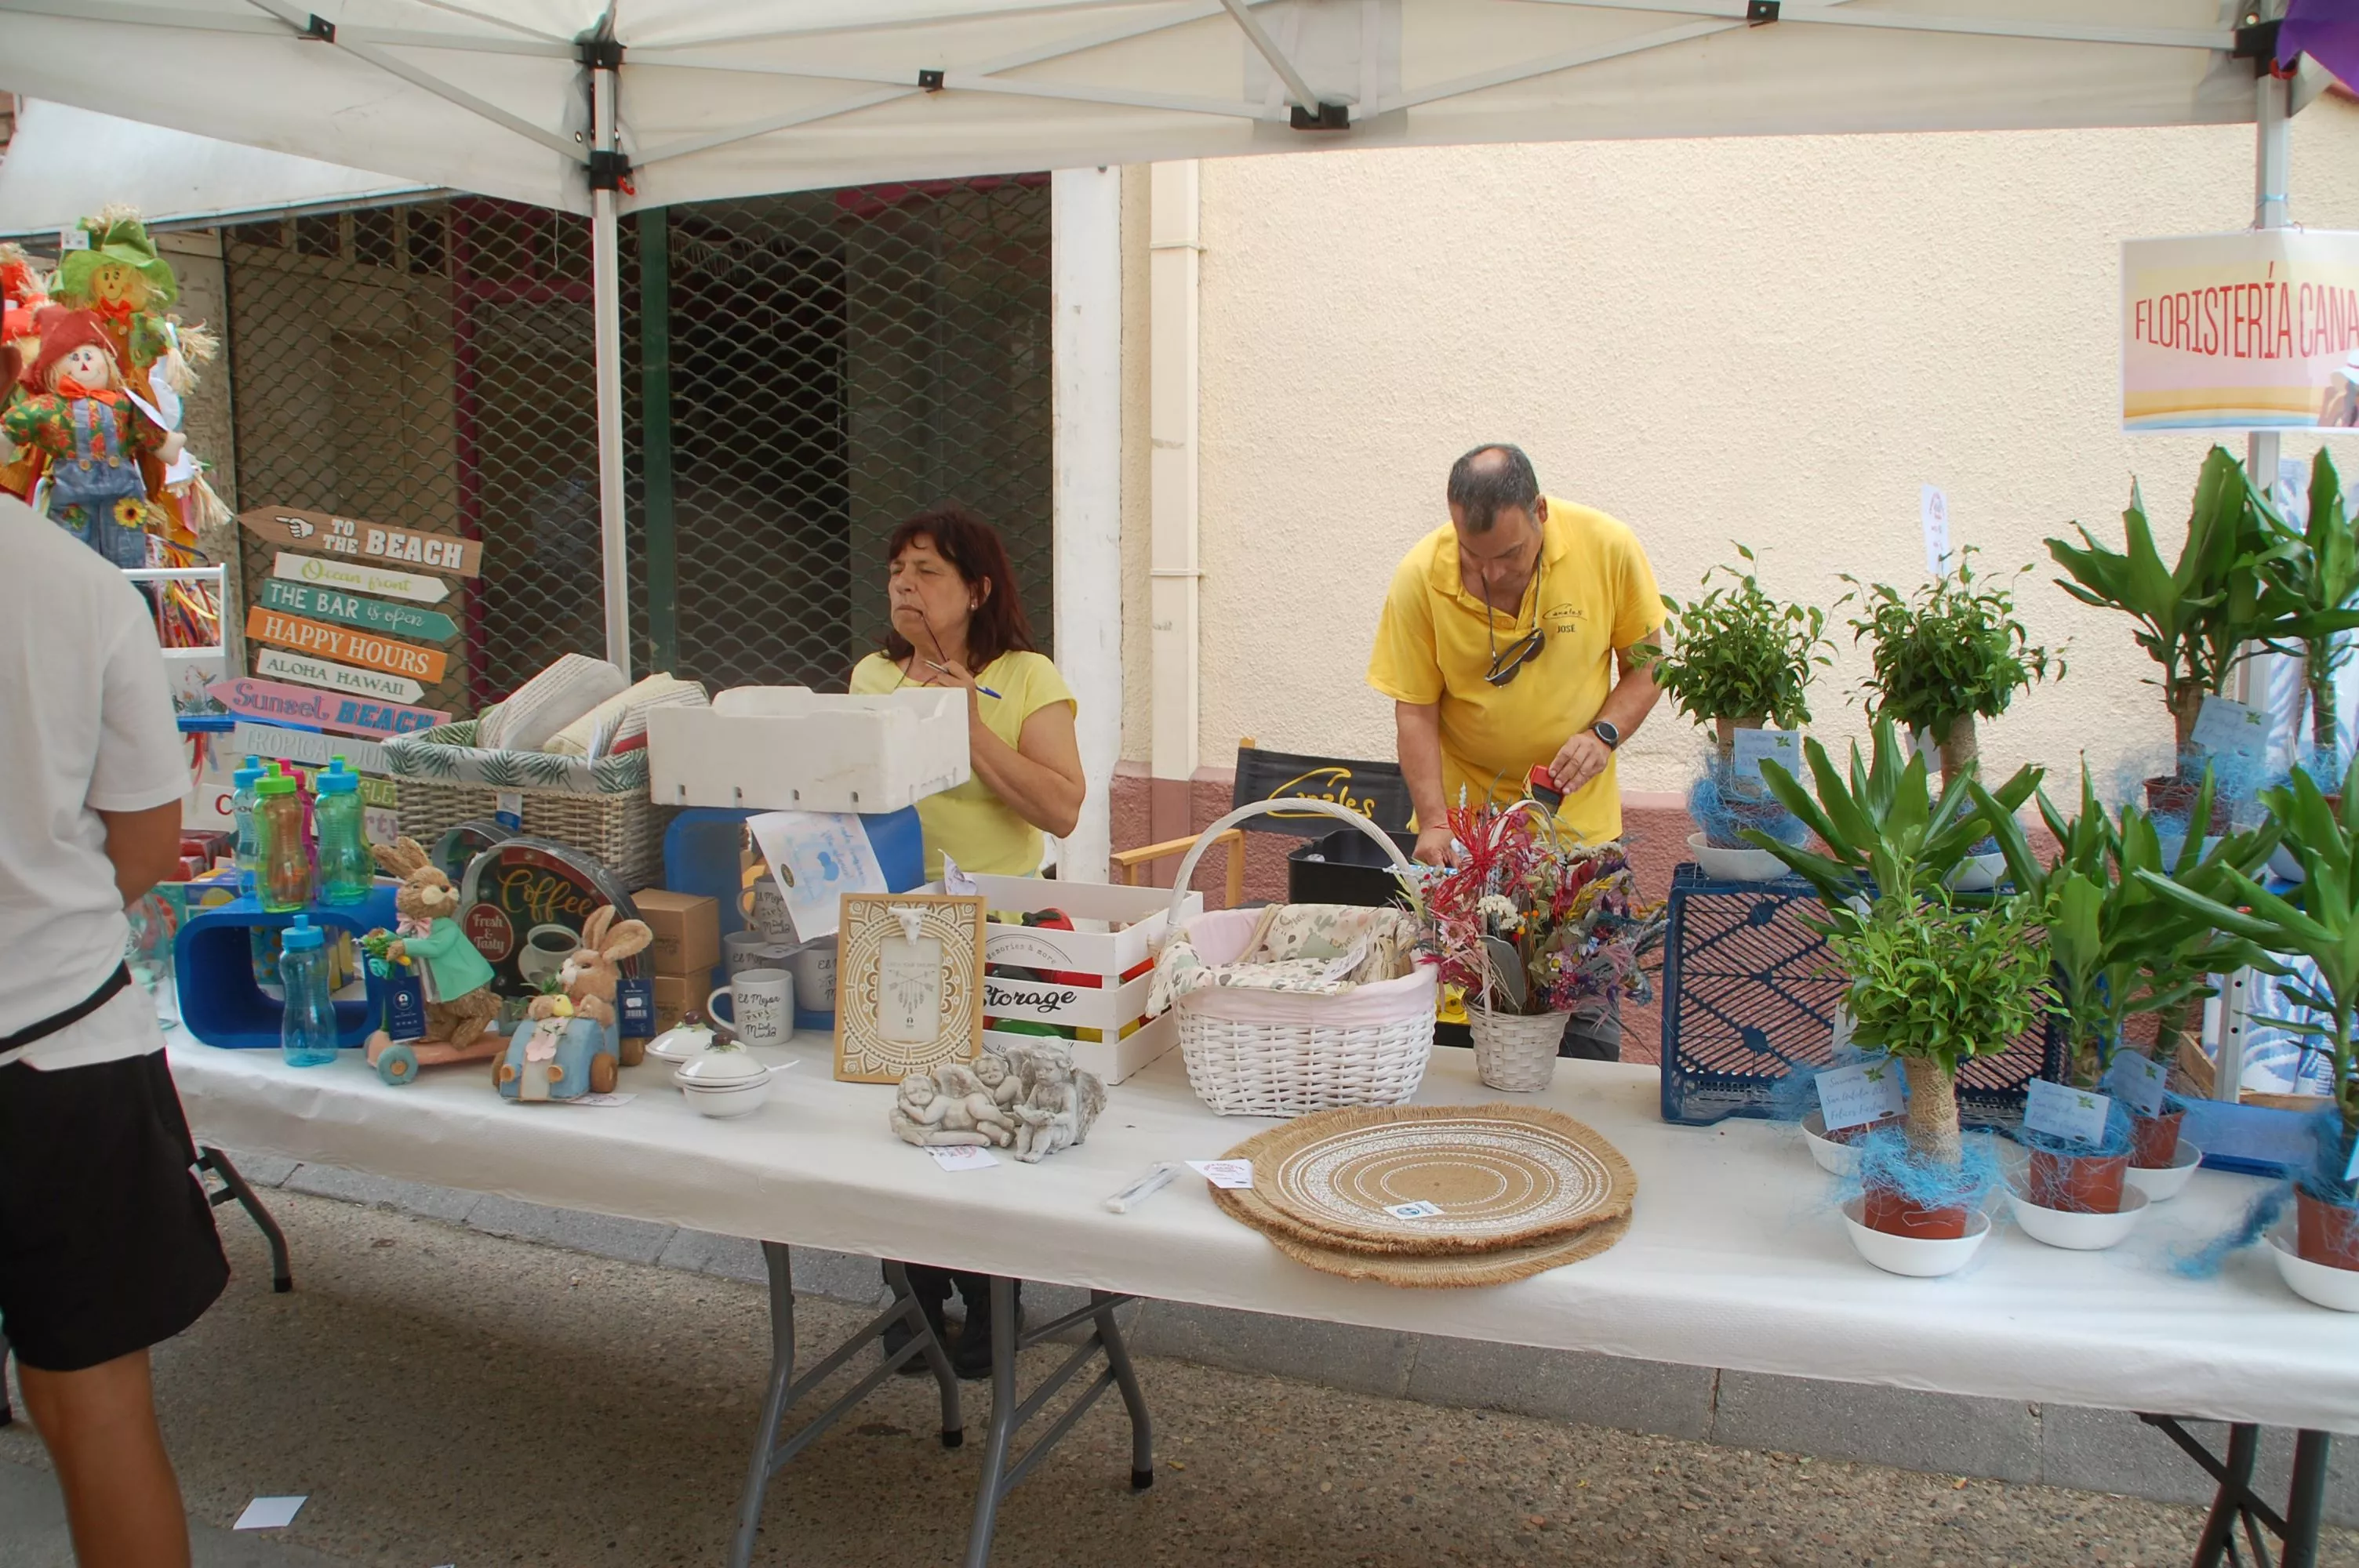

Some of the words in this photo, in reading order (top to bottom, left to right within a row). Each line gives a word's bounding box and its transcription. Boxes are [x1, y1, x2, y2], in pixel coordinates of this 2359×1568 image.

[2135, 260, 2292, 358] FLORISTERÍA
[332, 518, 354, 536] TO
[323, 534, 358, 554] THE
[365, 528, 463, 569] BEACH
[301, 559, 361, 583] Ocean
[368, 575, 412, 593] front
[271, 583, 307, 609] THE
[317, 593, 359, 619] BAR
[367, 602, 381, 620] is
[384, 607, 425, 630] open
[264, 616, 344, 653] HAPPY
[347, 636, 430, 675] HOURS
[267, 659, 328, 681] ALOHA
[336, 671, 405, 696] HAWAII
[233, 682, 329, 721] Sunset
[335, 700, 438, 735] BEACH
[247, 729, 339, 763] TROPICAL
[496, 869, 593, 922] Coffee
[472, 913, 503, 928] Fresh
[484, 928, 493, 938] &
[474, 938, 505, 953] Tasty
[986, 942, 1024, 961] Memories
[1036, 949, 1057, 964] more
[737, 993, 749, 1004] El
[751, 993, 780, 1007] Mejor
[983, 984, 1077, 1014] Storage
